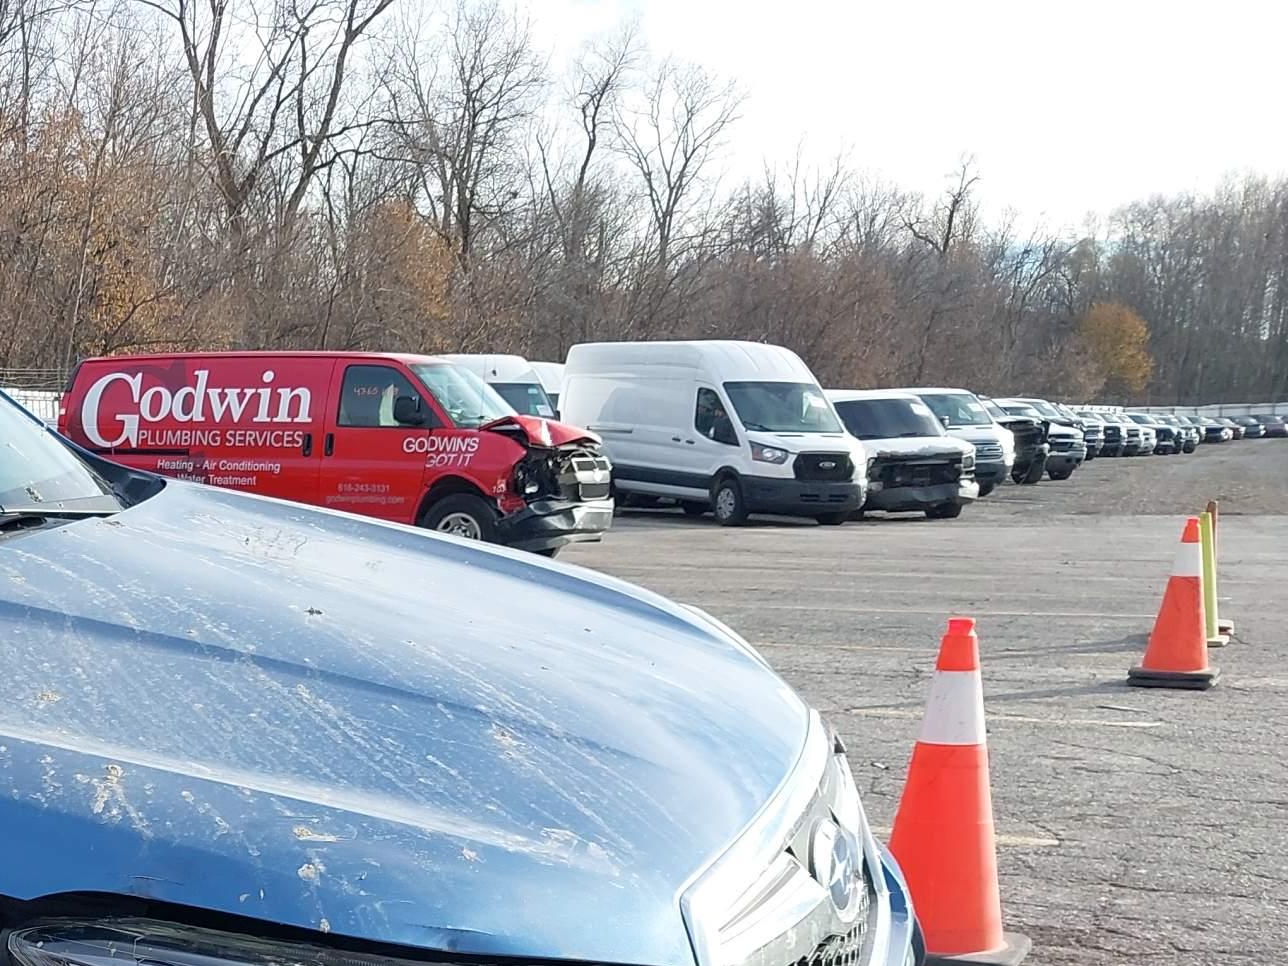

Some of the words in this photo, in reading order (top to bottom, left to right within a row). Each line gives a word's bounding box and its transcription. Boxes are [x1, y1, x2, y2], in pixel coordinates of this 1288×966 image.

[81, 370, 312, 448] Godwin
[138, 429, 220, 447] PLUMBING
[225, 430, 304, 448] SERVICES
[403, 436, 480, 454] GODWIN'S
[157, 459, 193, 472] Heating
[202, 460, 217, 470] Air
[219, 459, 281, 473] Conditioning
[456, 453, 475, 467] IT
[208, 474, 256, 486] Treatment
